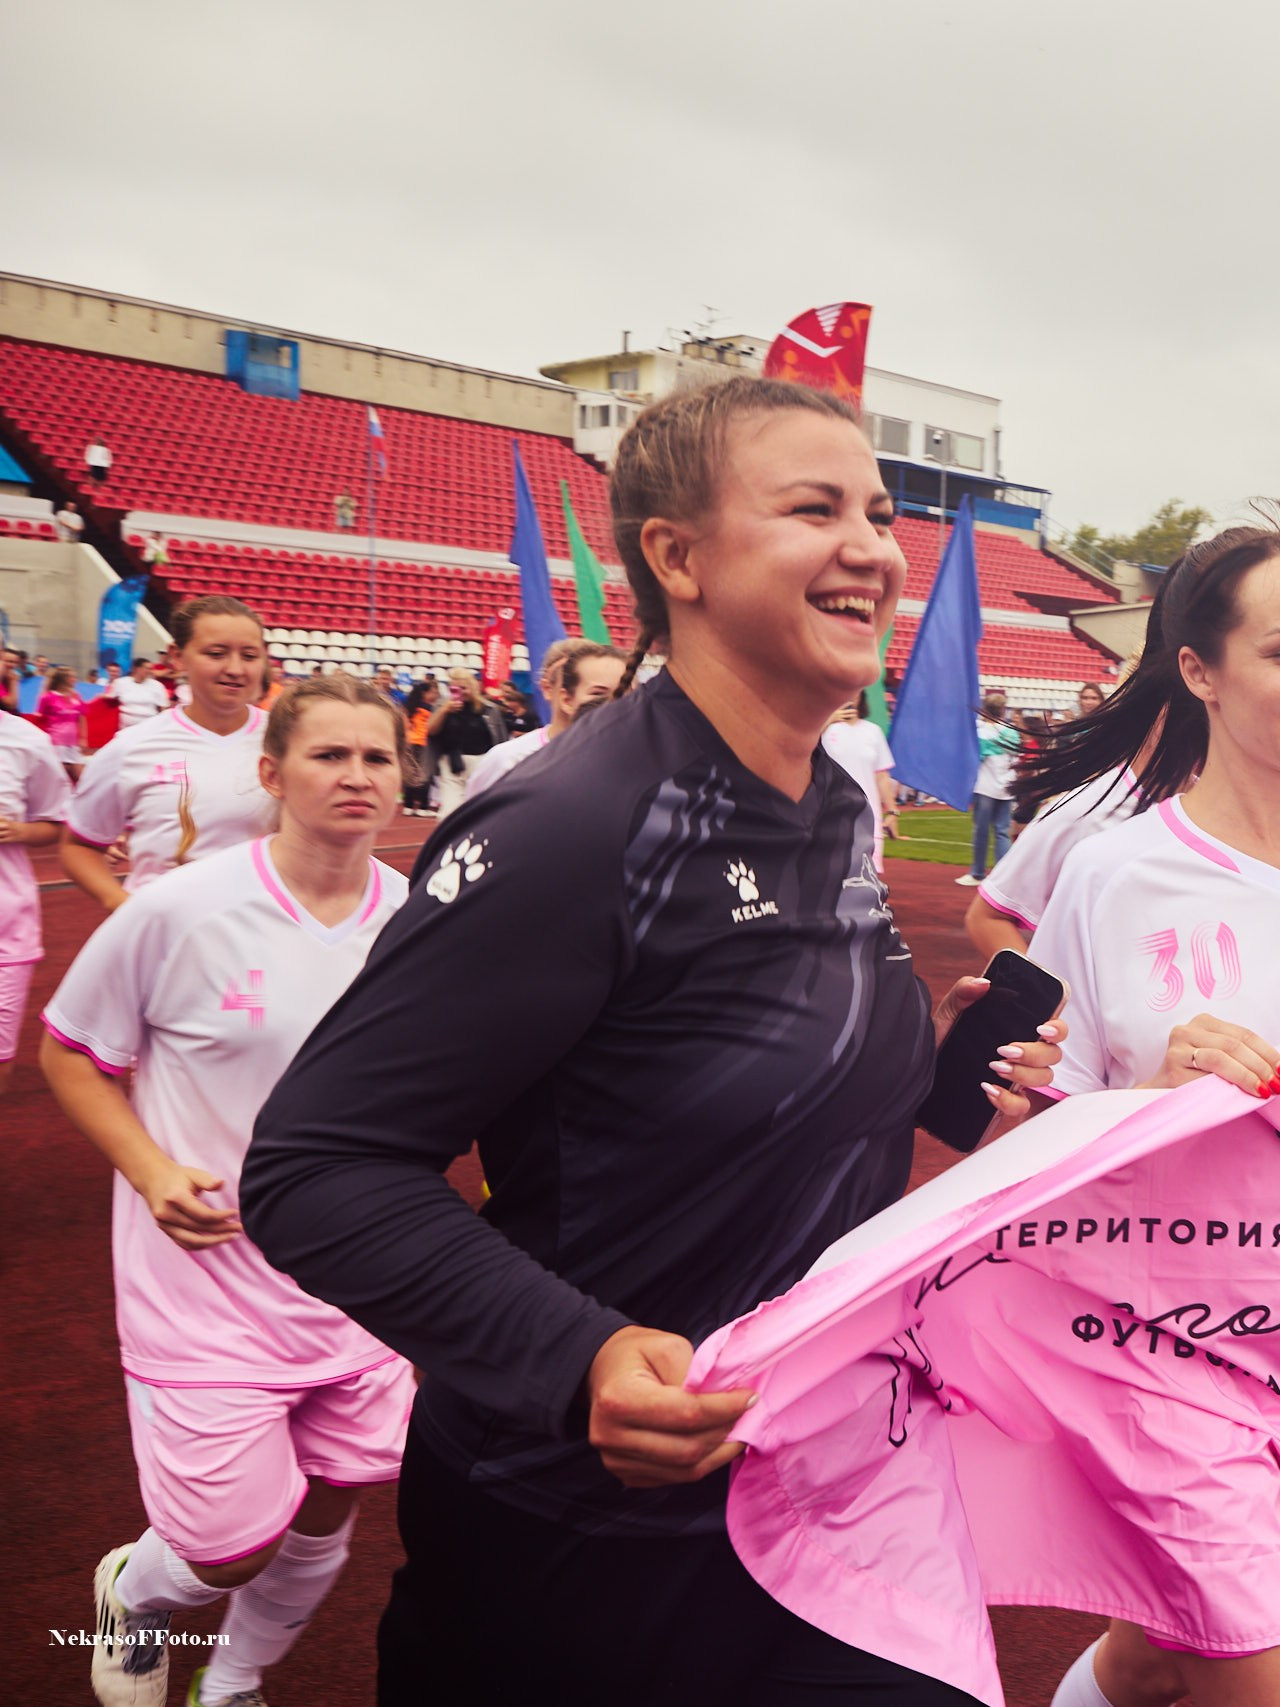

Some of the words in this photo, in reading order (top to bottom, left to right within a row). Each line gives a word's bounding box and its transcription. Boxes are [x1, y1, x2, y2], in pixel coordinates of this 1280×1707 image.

[731, 901, 779, 924] KELME
[1132, 921, 1242, 1012] 30
[219, 969, 267, 1030] 4
